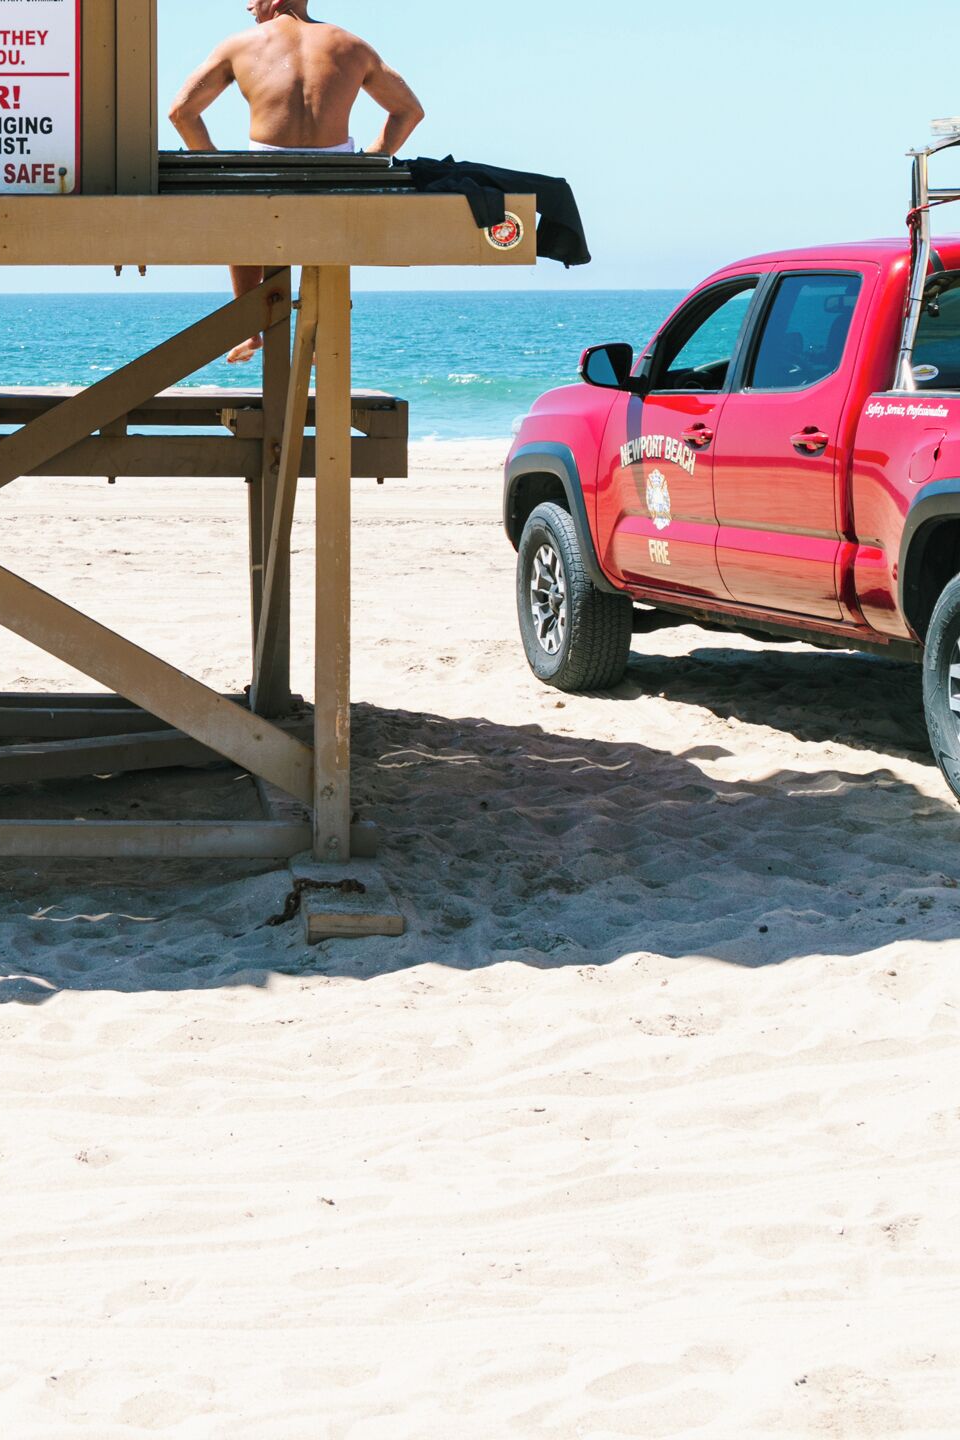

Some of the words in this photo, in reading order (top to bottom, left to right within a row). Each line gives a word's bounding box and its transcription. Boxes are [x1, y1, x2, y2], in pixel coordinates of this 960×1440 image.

[0, 30, 49, 46] THEY
[3, 163, 56, 184] SAFE
[865, 402, 885, 418] Safety,
[620, 435, 664, 469] NEWPORT
[664, 436, 697, 476] BEACH
[648, 539, 671, 565] FIRE
